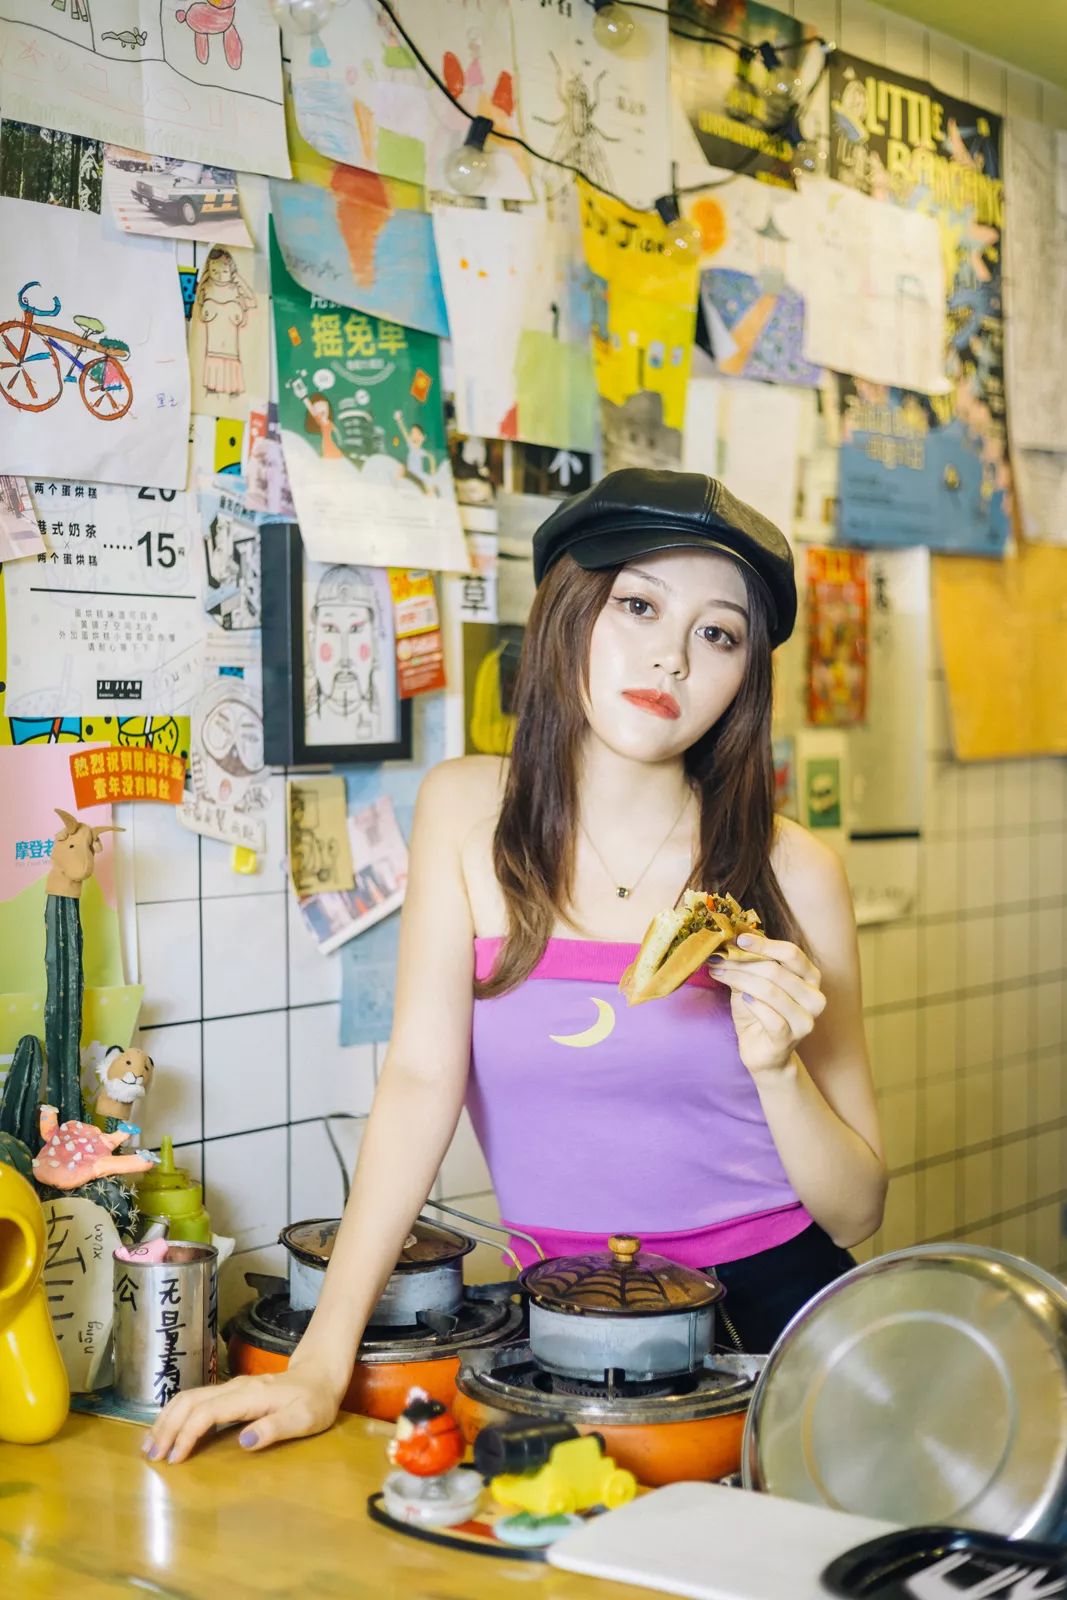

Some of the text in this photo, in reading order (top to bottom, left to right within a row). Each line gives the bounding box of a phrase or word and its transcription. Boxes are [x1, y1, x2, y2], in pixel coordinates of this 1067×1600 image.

[34, 482, 98, 499] 两个蛋烘糕
[37, 520, 97, 539] 港式奶茶
[37, 552, 98, 567] 两个蛋烘糕
